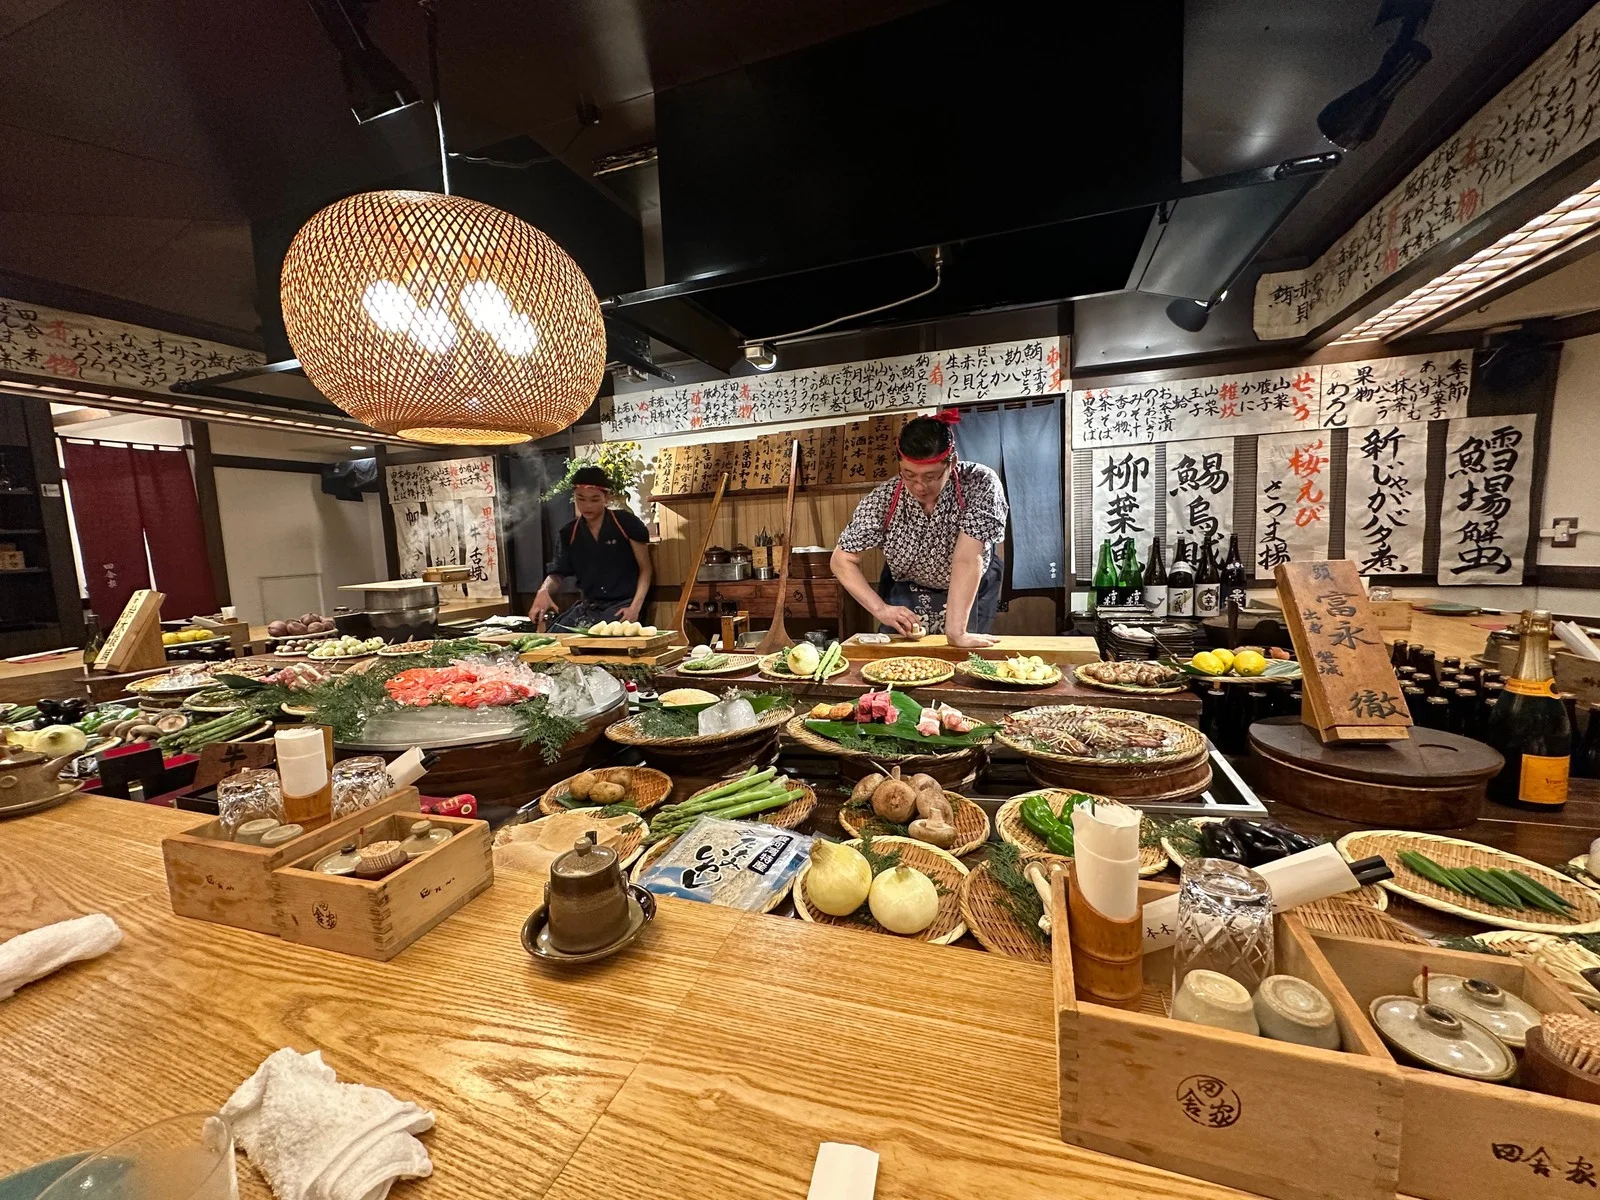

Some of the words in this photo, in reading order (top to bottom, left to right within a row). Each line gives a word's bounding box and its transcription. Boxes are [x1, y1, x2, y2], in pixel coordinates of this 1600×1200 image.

[1353, 366, 1376, 403] 果物
[1447, 359, 1469, 403] 季節
[1288, 438, 1330, 528] 桜えび
[1491, 1141, 1599, 1189] 田舎家
